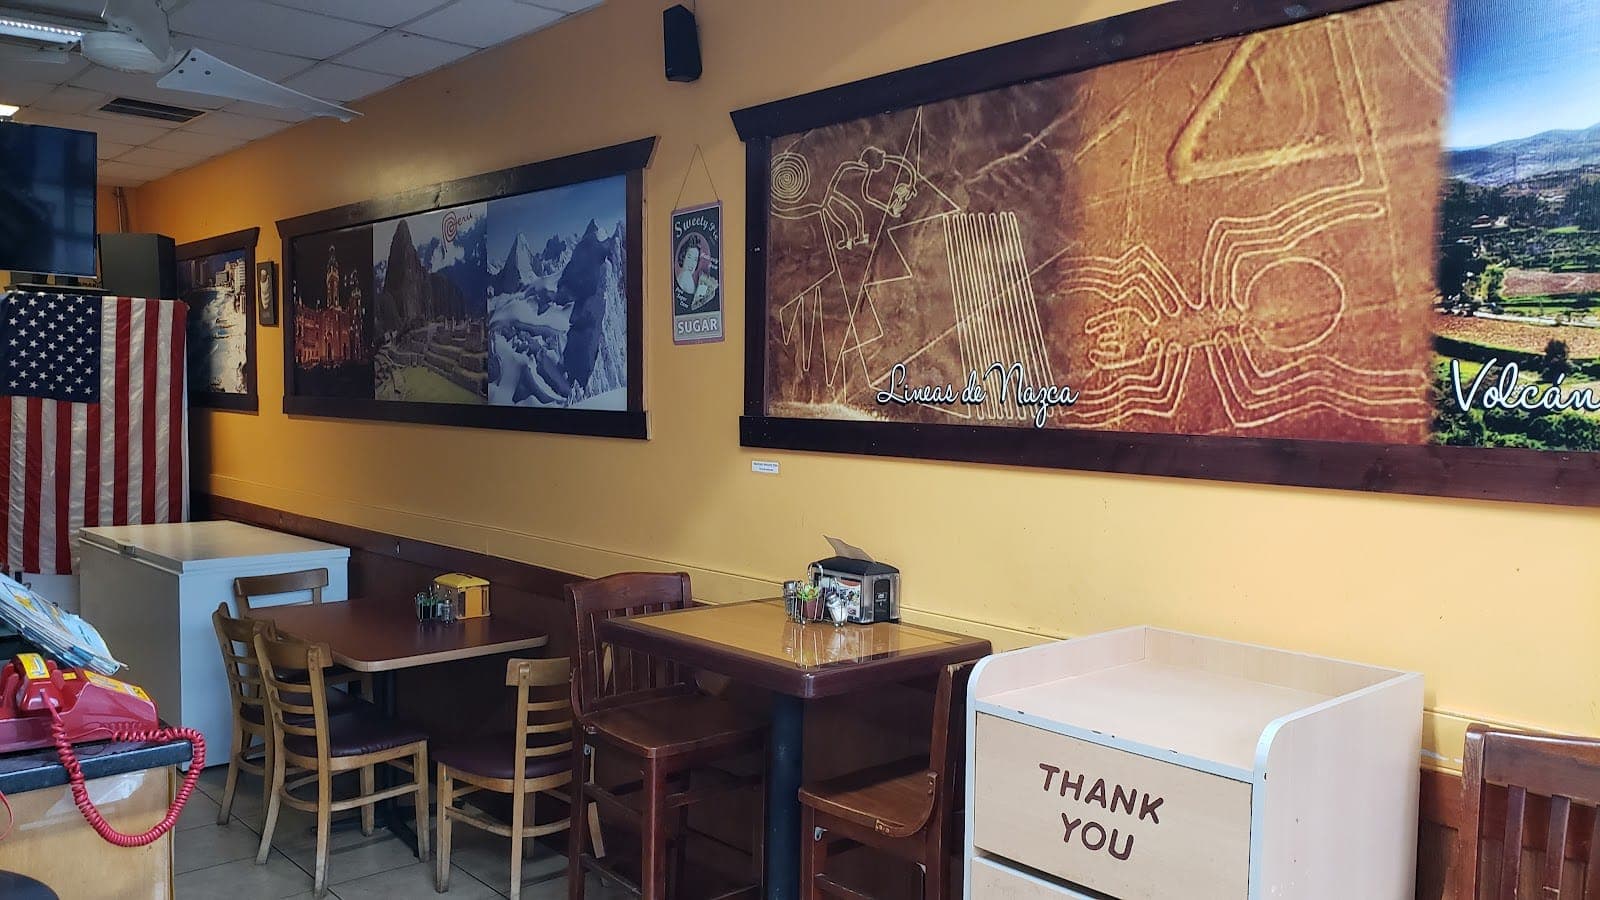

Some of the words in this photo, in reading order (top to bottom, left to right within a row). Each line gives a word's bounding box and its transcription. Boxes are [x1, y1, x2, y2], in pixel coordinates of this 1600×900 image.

[674, 216, 709, 238] Sweety
[677, 318, 718, 334] SUGAR
[960, 369, 987, 404] de
[982, 362, 1079, 428] Nazca
[1451, 357, 1600, 412] Volcán
[1038, 762, 1165, 825] THANK
[1061, 812, 1135, 861] YOU
